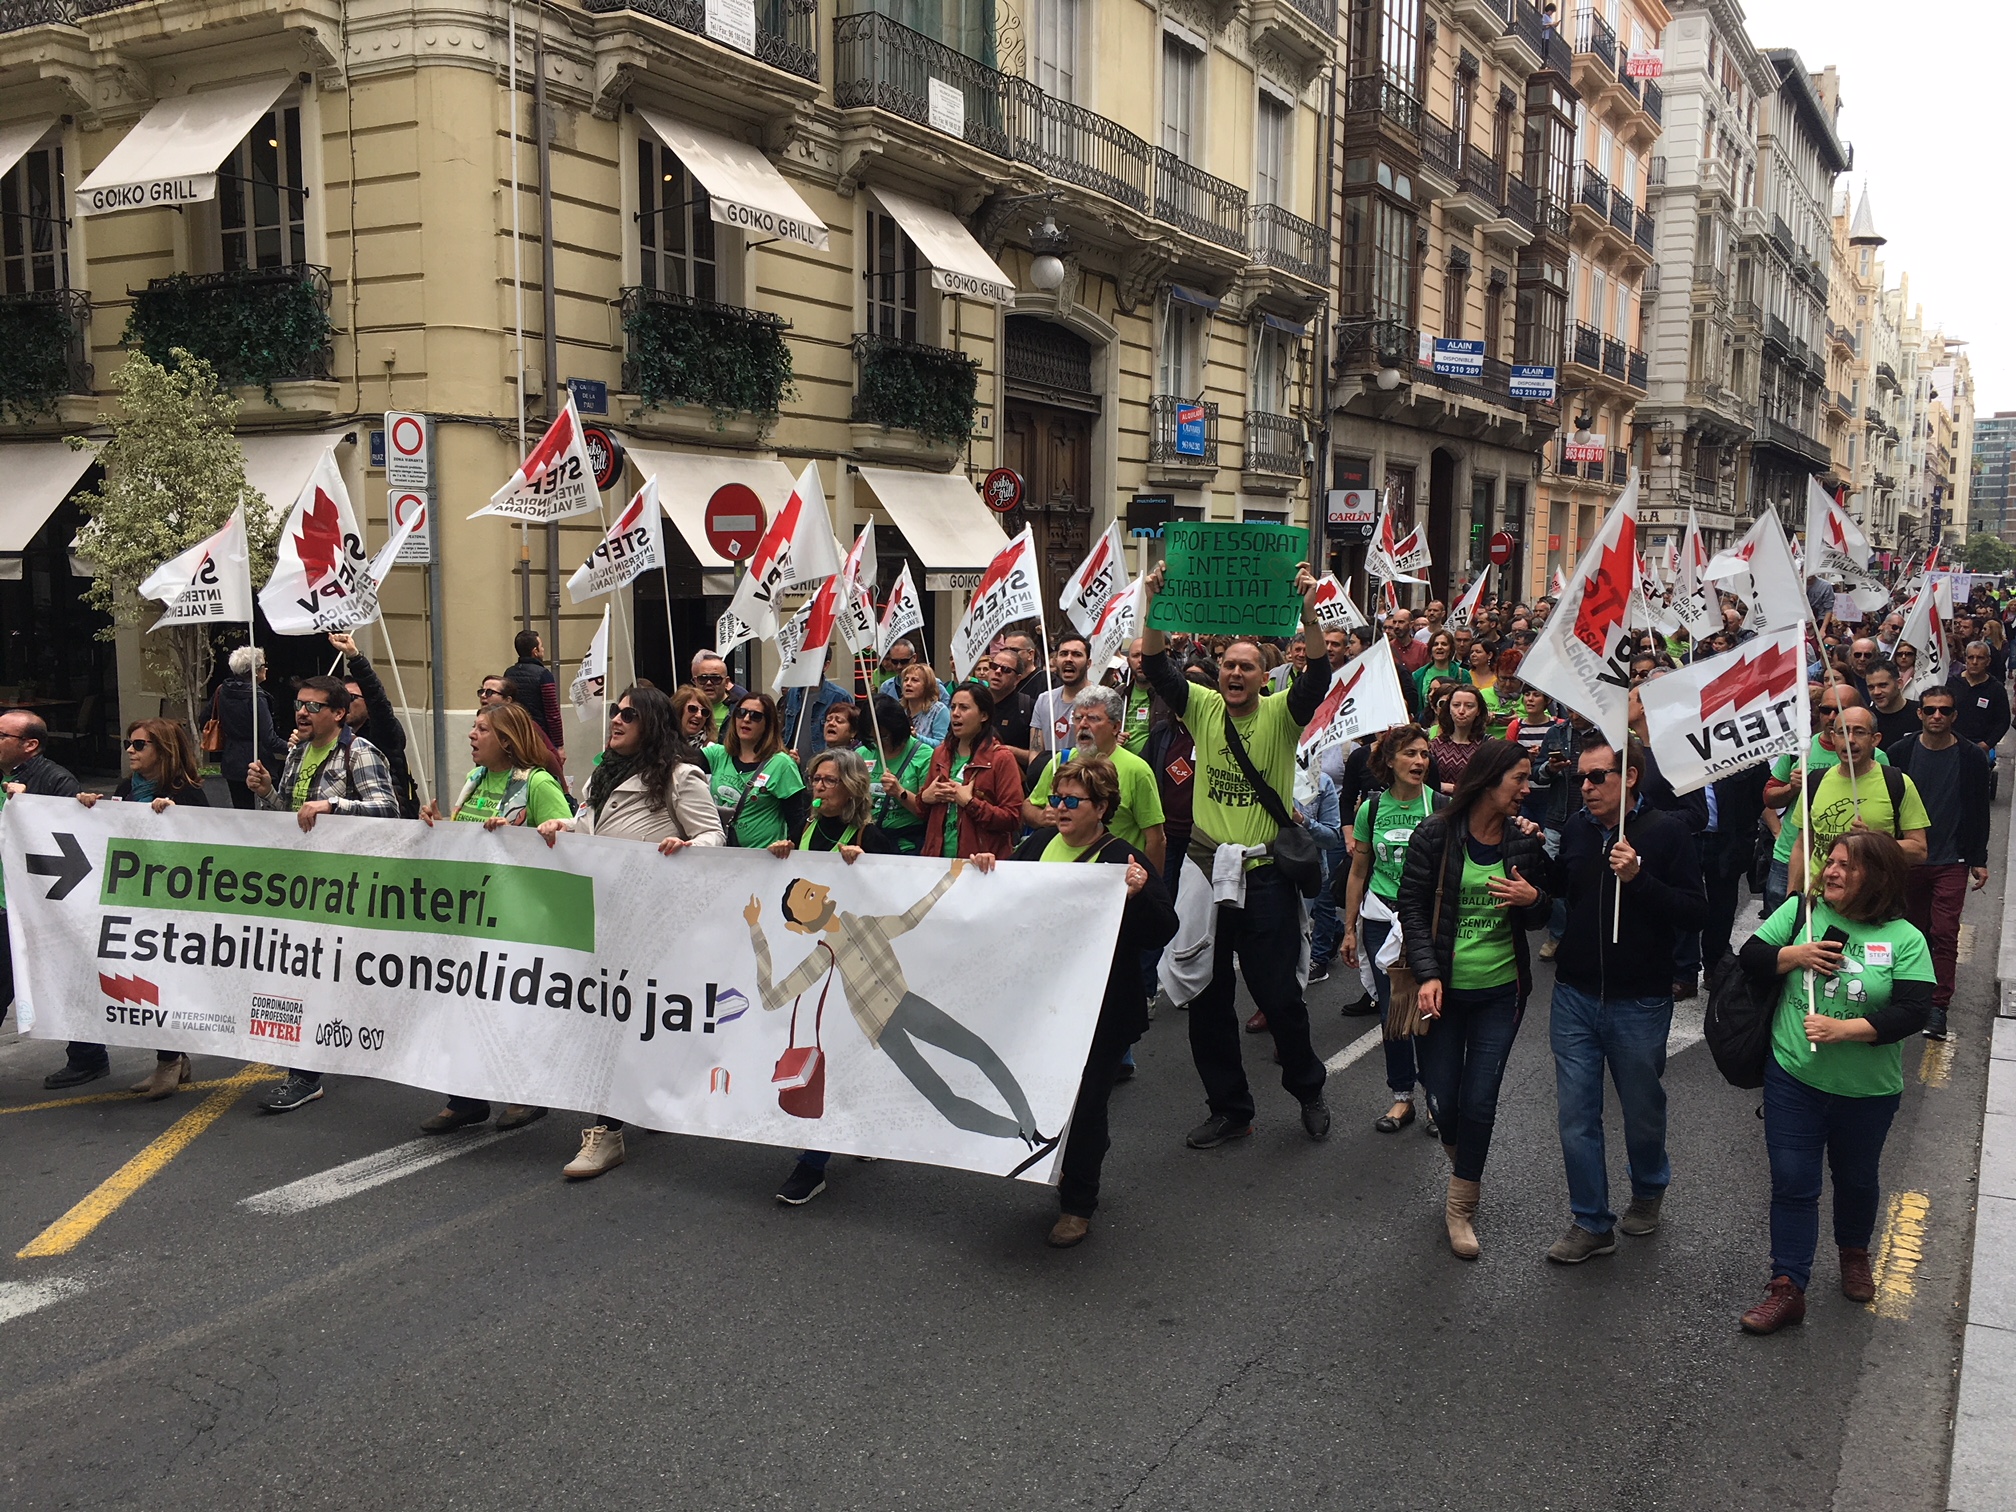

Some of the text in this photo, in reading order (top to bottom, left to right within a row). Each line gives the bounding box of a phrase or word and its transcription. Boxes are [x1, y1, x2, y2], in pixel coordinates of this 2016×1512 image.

[93, 180, 197, 210] GOIKO GRILL
[727, 203, 814, 245] GOIKO GRILL
[944, 272, 1006, 301] GOIKO GRILL
[1447, 342, 1472, 350] ALAIN
[1566, 448, 1602, 460] 963 44 60 10
[989, 476, 1010, 496] goiko
[995, 484, 1014, 506] grill
[1172, 530, 1300, 554] PROFESSORAT
[1362, 526, 1372, 536] hp
[1188, 553, 1261, 576] INTERÍ
[950, 574, 980, 588] GOIKO
[1152, 602, 1300, 626] CONSOLIDACIÓ!
[107, 850, 498, 929] Professorat interí.
[97, 915, 718, 1042] Estabilitat i consolidació ja!
[252, 996, 303, 1014] COORDINADORA
[106, 1006, 168, 1028] STEPV
[172, 1011, 236, 1025] INTERSINDICAL
[182, 1022, 236, 1034] VALENCIANA
[251, 1008, 302, 1026] DE PROFESSORAT
